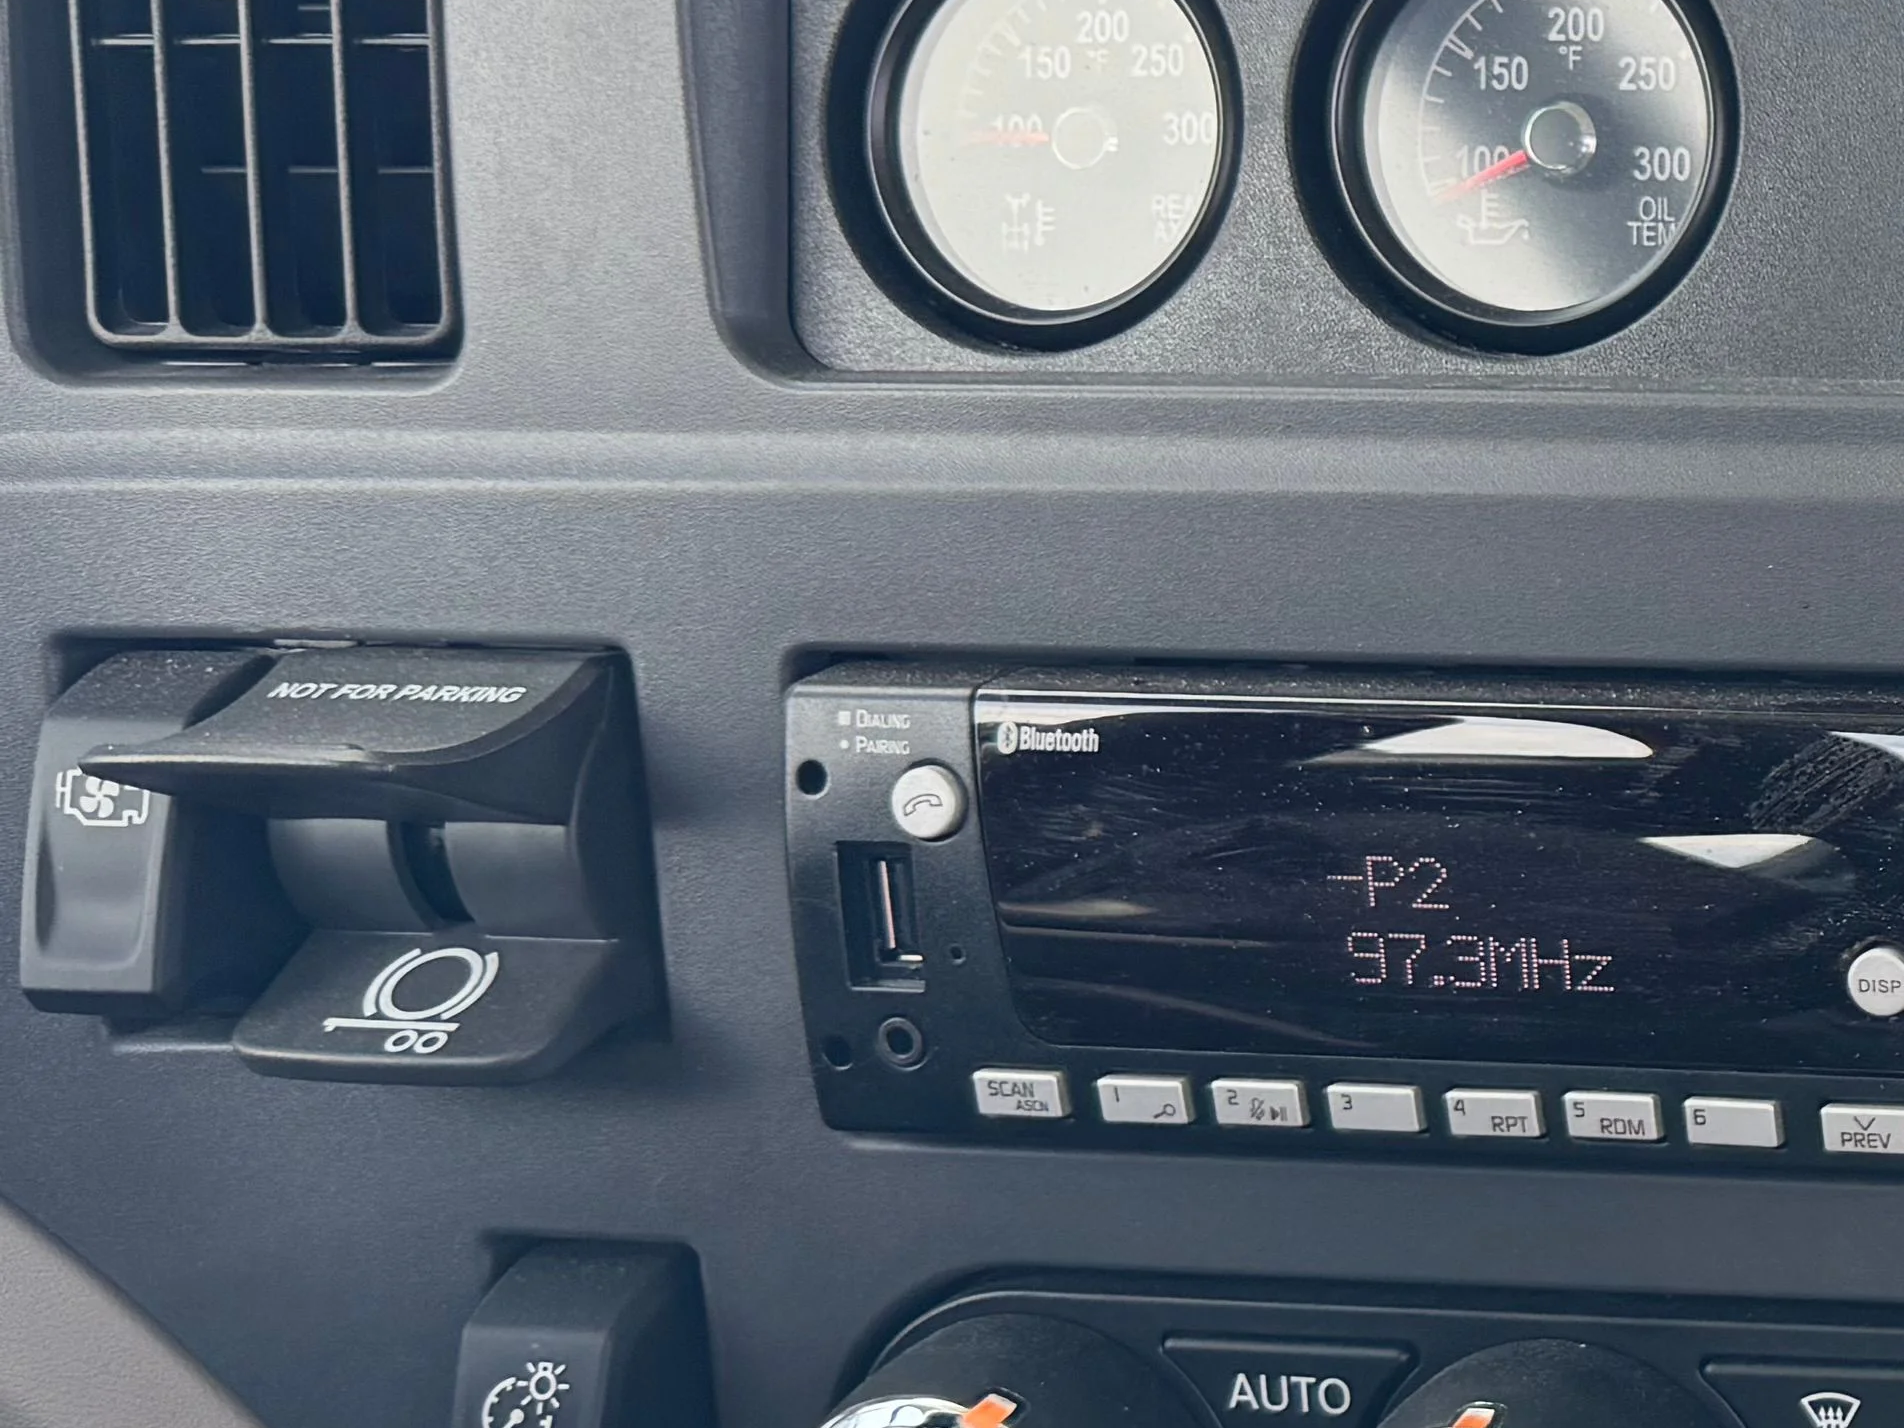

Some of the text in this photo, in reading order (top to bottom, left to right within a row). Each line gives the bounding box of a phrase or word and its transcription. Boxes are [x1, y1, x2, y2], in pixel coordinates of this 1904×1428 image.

[1076, 9, 1131, 44] 200
[1548, 6, 1606, 42] 200
[1017, 45, 1072, 80] 150
[1131, 43, 1186, 77] 250
[1473, 56, 1530, 91] 150
[1618, 56, 1677, 91] 250
[1163, 111, 1219, 146] 300
[1633, 146, 1691, 182] 300
[1638, 196, 1676, 223] OIL
[266, 682, 528, 704] NOT FOR PARKING
[1018, 725, 1100, 755] Bluetooth
[1347, 932, 1616, 993] 97.3MHz
[1857, 979, 1903, 998] DISP
[986, 1081, 1035, 1098] SCAN
[1226, 1089, 1241, 1106] 2
[1341, 1094, 1353, 1111] 3
[1453, 1099, 1467, 1117] 4
[1572, 1102, 1587, 1119] 5
[1692, 1109, 1707, 1126] 6
[1490, 1116, 1529, 1134] RPT
[1599, 1117, 1647, 1136] RDM
[1840, 1132, 1892, 1149] PREV
[1228, 1373, 1352, 1414] AUTO
